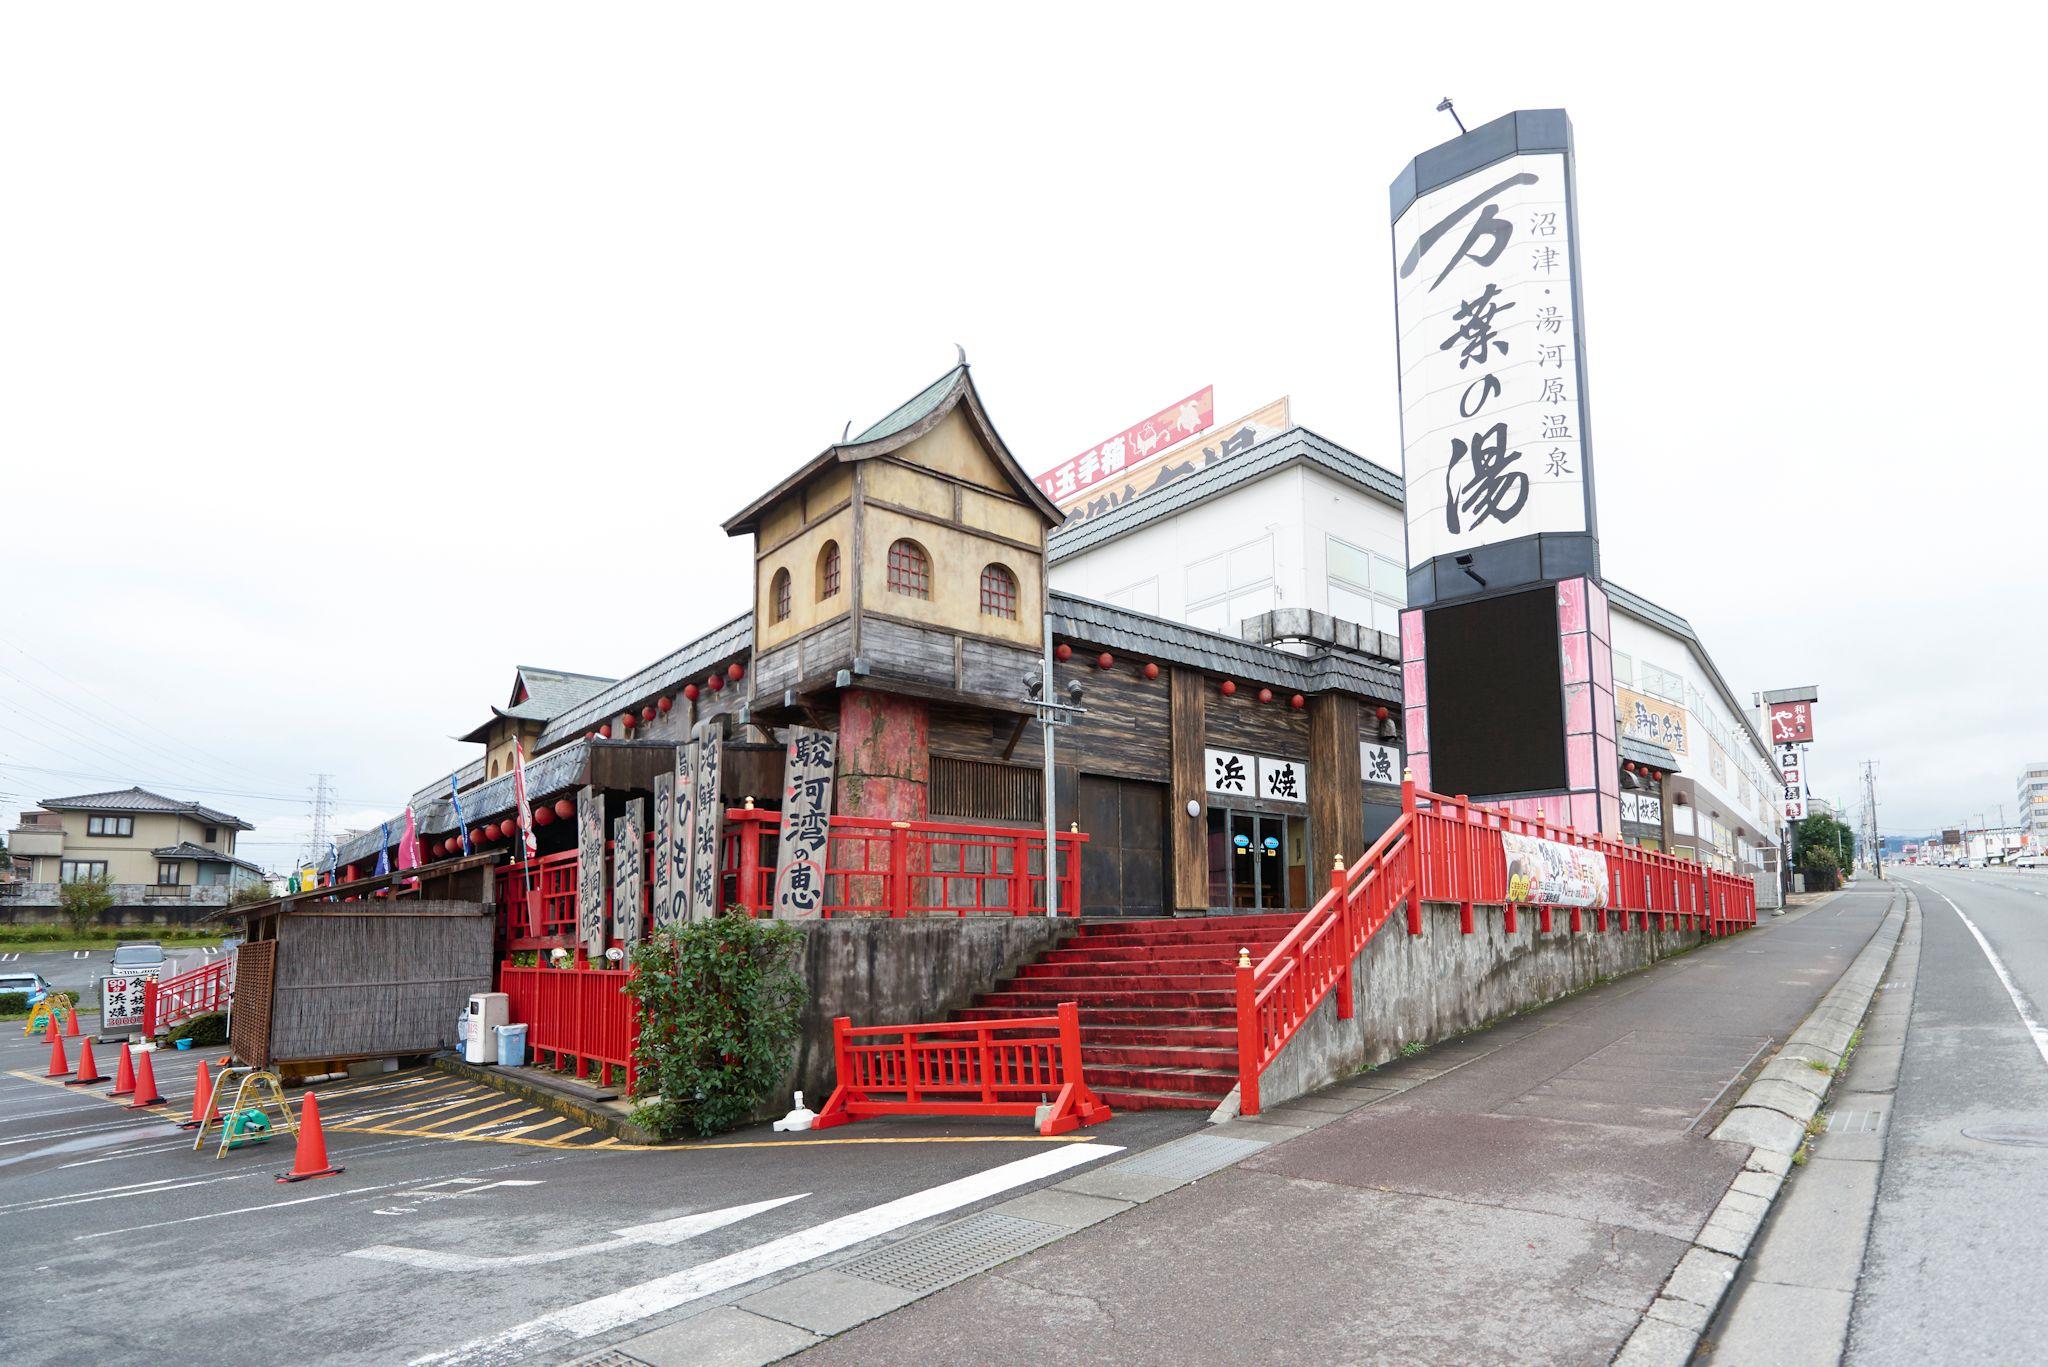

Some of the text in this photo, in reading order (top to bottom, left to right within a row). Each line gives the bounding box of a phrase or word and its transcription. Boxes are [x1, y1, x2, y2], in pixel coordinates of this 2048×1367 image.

[1400, 172, 1540, 535] 万葉の湯
[783, 731, 833, 910] 駿河湾の恵
[1368, 746, 1393, 782] 漁
